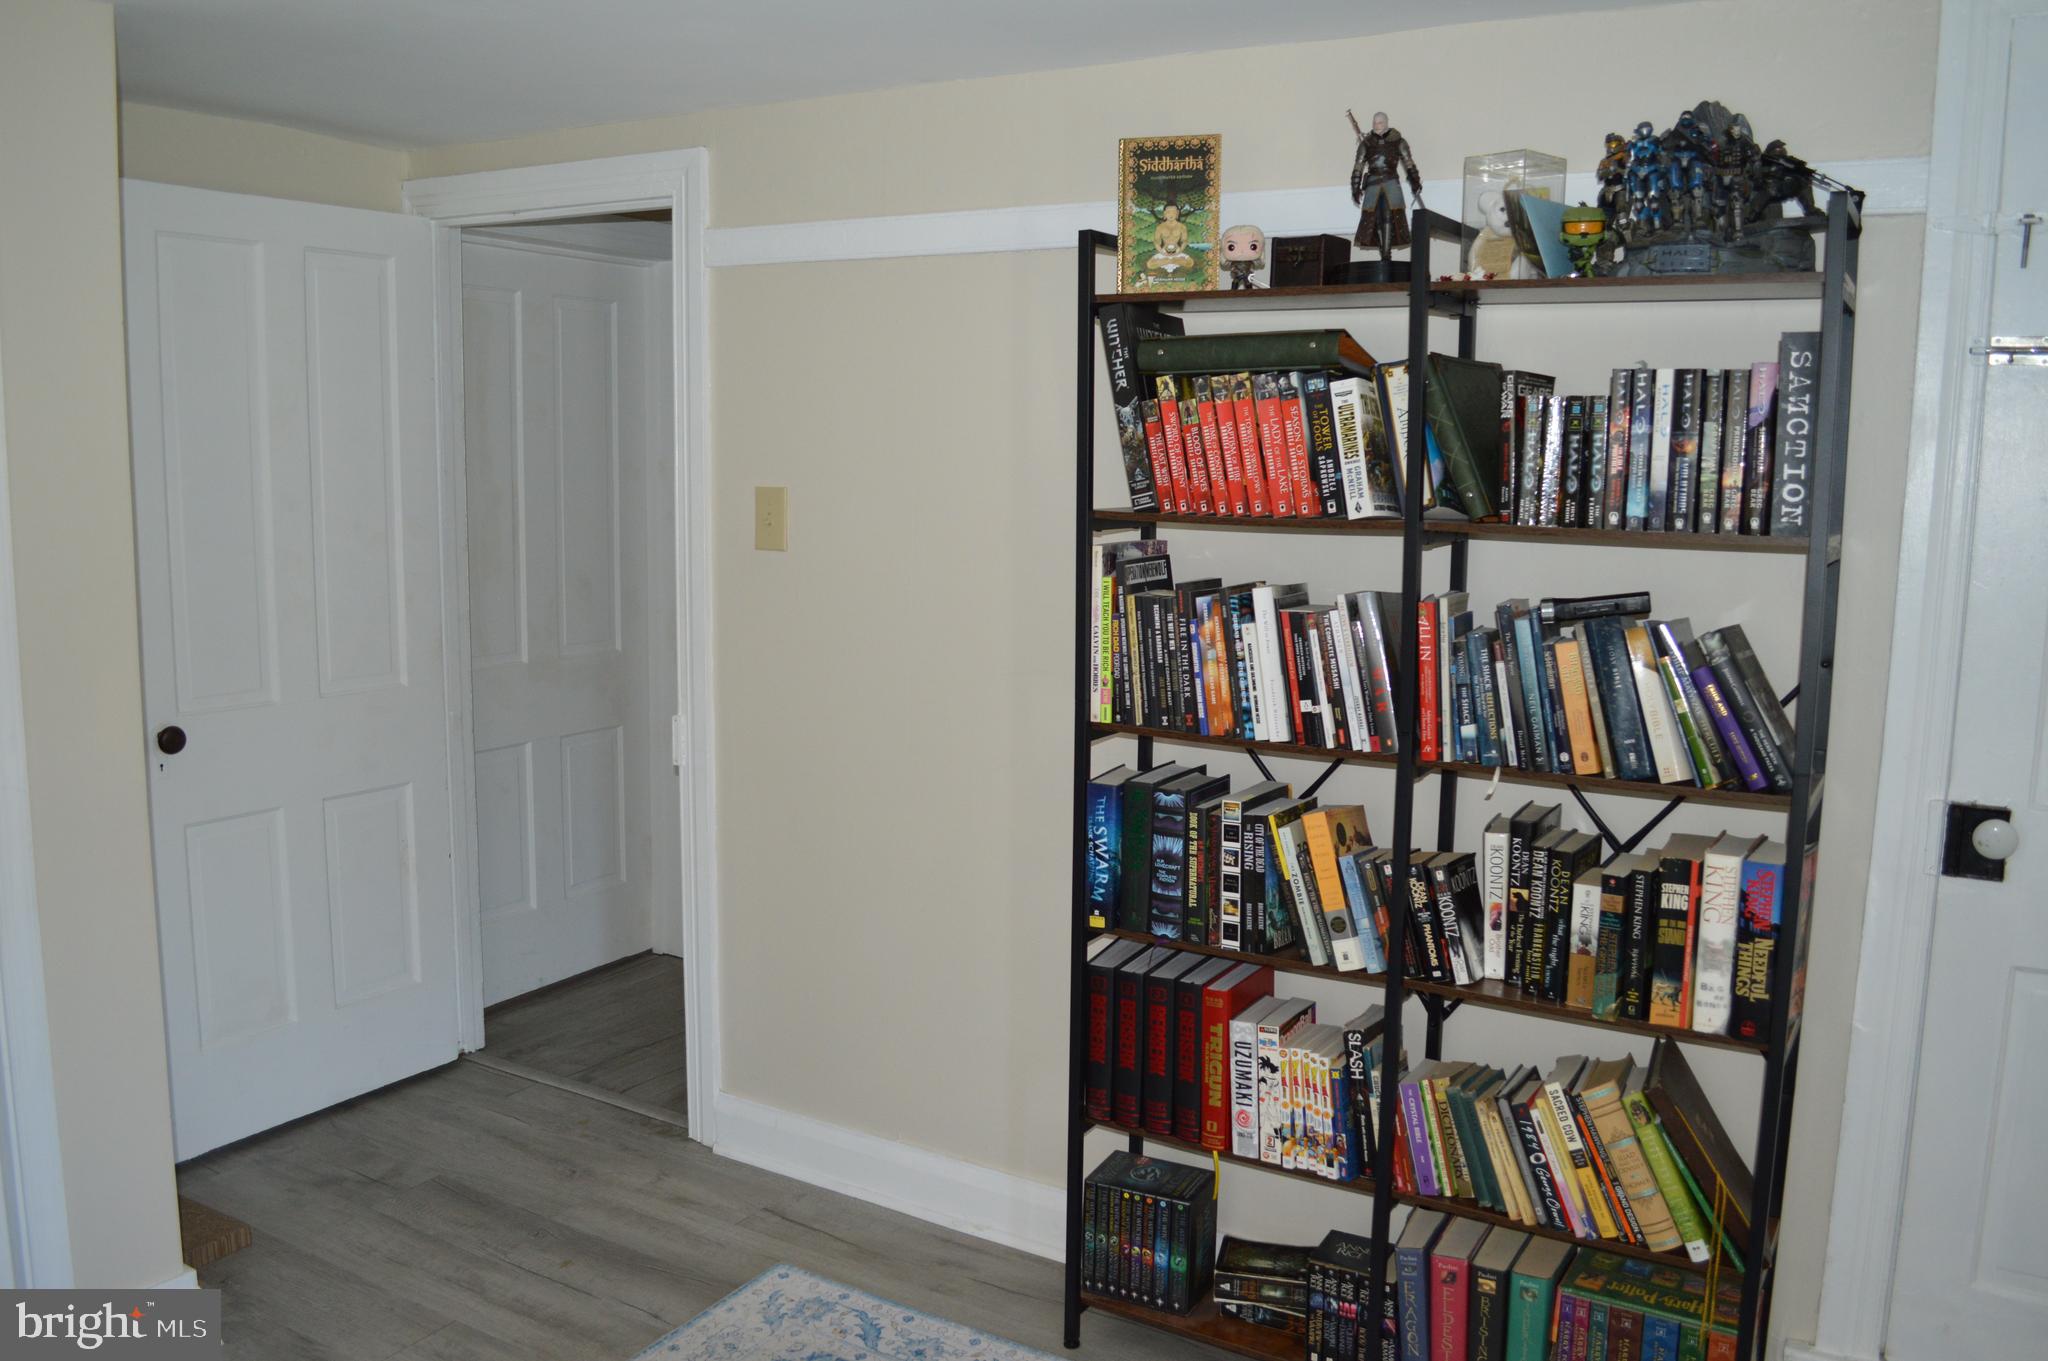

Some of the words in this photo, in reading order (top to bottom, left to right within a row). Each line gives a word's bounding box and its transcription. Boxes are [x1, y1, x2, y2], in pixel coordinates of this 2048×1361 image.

[1140, 155, 1204, 175] Siddhartha
[1104, 318, 1128, 392] WITCHER
[1613, 370, 1627, 426] HALO
[1633, 372, 1648, 434] HALO
[1680, 373, 1693, 428] HALO
[1709, 377, 1719, 420] HALO
[1730, 371, 1742, 419] HALO
[1756, 366, 1767, 414] HALO
[1167, 410, 1179, 441] SWORD
[1289, 405, 1302, 442] SEASON
[1311, 409, 1318, 418] OF
[1658, 383, 1670, 438] HALO
[1154, 432, 1162, 445] THE
[1190, 426, 1201, 455] BLOOD
[1311, 419, 1323, 452] FOOLS
[1318, 406, 1333, 450] TOWER
[1336, 402, 1361, 460] ULTRAMARINES
[1779, 350, 1814, 526] SANCTION
[1156, 445, 1165, 464] LAST
[1172, 442, 1181, 453] OF
[1195, 456, 1203, 468] OF
[1224, 421, 1237, 455] BAPTISM
[1232, 465, 1241, 481] FIRE
[1268, 416, 1282, 446] LADY
[1276, 468, 1288, 494] LAKE
[1295, 443, 1305, 457] OF
[1523, 430, 1536, 489] HALO
[1565, 433, 1580, 494] HALO
[1590, 431, 1604, 493] HALO
[1159, 466, 1169, 486] WISH
[1174, 454, 1186, 487] DESTINY
[1197, 468, 1207, 492] ELVES
[1297, 458, 1310, 498] STORMS
[1317, 454, 1330, 496] SAPKOWSKI
[1325, 458, 1337, 491] ANDRZEJ
[1353, 465, 1365, 498] GRAHAM
[1677, 456, 1689, 513] EVOLUTIONS
[1587, 496, 1595, 524] FLOOD
[1178, 617, 1187, 638] FIRE
[1322, 614, 1330, 625] THE
[1418, 615, 1431, 642] ALL
[1102, 636, 1109, 644] TO
[1102, 646, 1109, 654] BE
[1155, 634, 1163, 663] BARBARIAN
[1180, 639, 1187, 650] IN
[1324, 626, 1334, 657] COMPLETE
[1419, 645, 1430, 660] IN
[1504, 642, 1514, 660] Viking
[1181, 653, 1189, 670] THE
[1328, 657, 1339, 689] MUSASHI
[1456, 650, 1466, 676] YOUNG
[1607, 644, 1616, 665] HOLY
[1612, 667, 1621, 688] BIBLE
[1182, 673, 1190, 697] DARK
[1479, 647, 1489, 663] THE
[1484, 690, 1497, 739] REFLECTIONS
[1460, 698, 1470, 724] SHACK
[1527, 692, 1537, 713] NEIL
[1530, 716, 1543, 754] GAIMAN
[1094, 795, 1106, 822] THE
[1188, 811, 1197, 828] BOOK
[1188, 830, 1197, 838] OF
[1254, 823, 1264, 836] CITY
[1254, 836, 1264, 844] OF
[1089, 825, 1110, 902] SWARM
[1188, 840, 1197, 854] THE
[1243, 831, 1253, 870] RISING
[1254, 845, 1264, 856] THE
[1510, 837, 1521, 886] KOONTZ
[1520, 850, 1529, 874] DEAN
[1530, 849, 1544, 876] DEAN
[1255, 857, 1264, 872] DEAD
[1489, 848, 1503, 899] KOONTZ
[1188, 856, 1197, 907] SUPERNATURAL
[1290, 872, 1305, 905] ZOMBIE
[1408, 876, 1422, 909] KOONTZ
[1417, 880, 1428, 903] DEAN
[1548, 858, 1562, 912] KOONTZ
[1558, 870, 1570, 905] DEAN
[1633, 874, 1644, 913] STEPHEN
[1661, 882, 1689, 895] STEPHEN
[1701, 864, 1725, 923] KING
[1720, 865, 1737, 924] STEPHEN
[1743, 878, 1760, 918] KING
[1527, 879, 1542, 918] KOONTZ
[1661, 893, 1689, 911] KING
[1752, 869, 1776, 931] STEPHEN
[1436, 894, 1460, 939] KOONTZ
[1578, 905, 1590, 936] KING
[1632, 915, 1642, 939] KING
[1422, 922, 1439, 967] PHANTOMS
[1529, 923, 1544, 979] FRANKENSTEIN
[1547, 947, 1559, 966] night
[1551, 934, 1560, 946] the
[1511, 948, 1522, 973] Evening
[1629, 948, 1639, 979] REVIVAL
[1733, 941, 1753, 996] THINGS
[1749, 937, 1774, 1002] NEEDFUL
[1209, 1023, 1222, 1107] TRIGUN
[1347, 1031, 1364, 1080] SLASH
[1233, 1040, 1253, 1107] UZUMAKI
[1408, 1096, 1419, 1125] CRYSTAL
[1548, 1087, 1569, 1123] SACRED
[1561, 1122, 1577, 1144] COW
[1574, 1095, 1593, 1127] STEPHEN
[1587, 1125, 1607, 1159] HAWKING
[1266, 1136, 1274, 1147] 2
[1412, 1125, 1422, 1144] BIBLE
[1438, 1099, 1463, 1179] DICTIONARY
[1518, 1117, 1540, 1155] 1984
[1535, 1164, 1556, 1197] George
[1544, 1195, 1566, 1229] Orwell
[1613, 1184, 1628, 1207] GRAND
[1624, 1207, 1640, 1233] DESIGN
[1606, 1280, 1659, 1306] Potter
[1662, 1296, 1704, 1315] Harry
[1403, 1280, 1420, 1357] ERAGON
